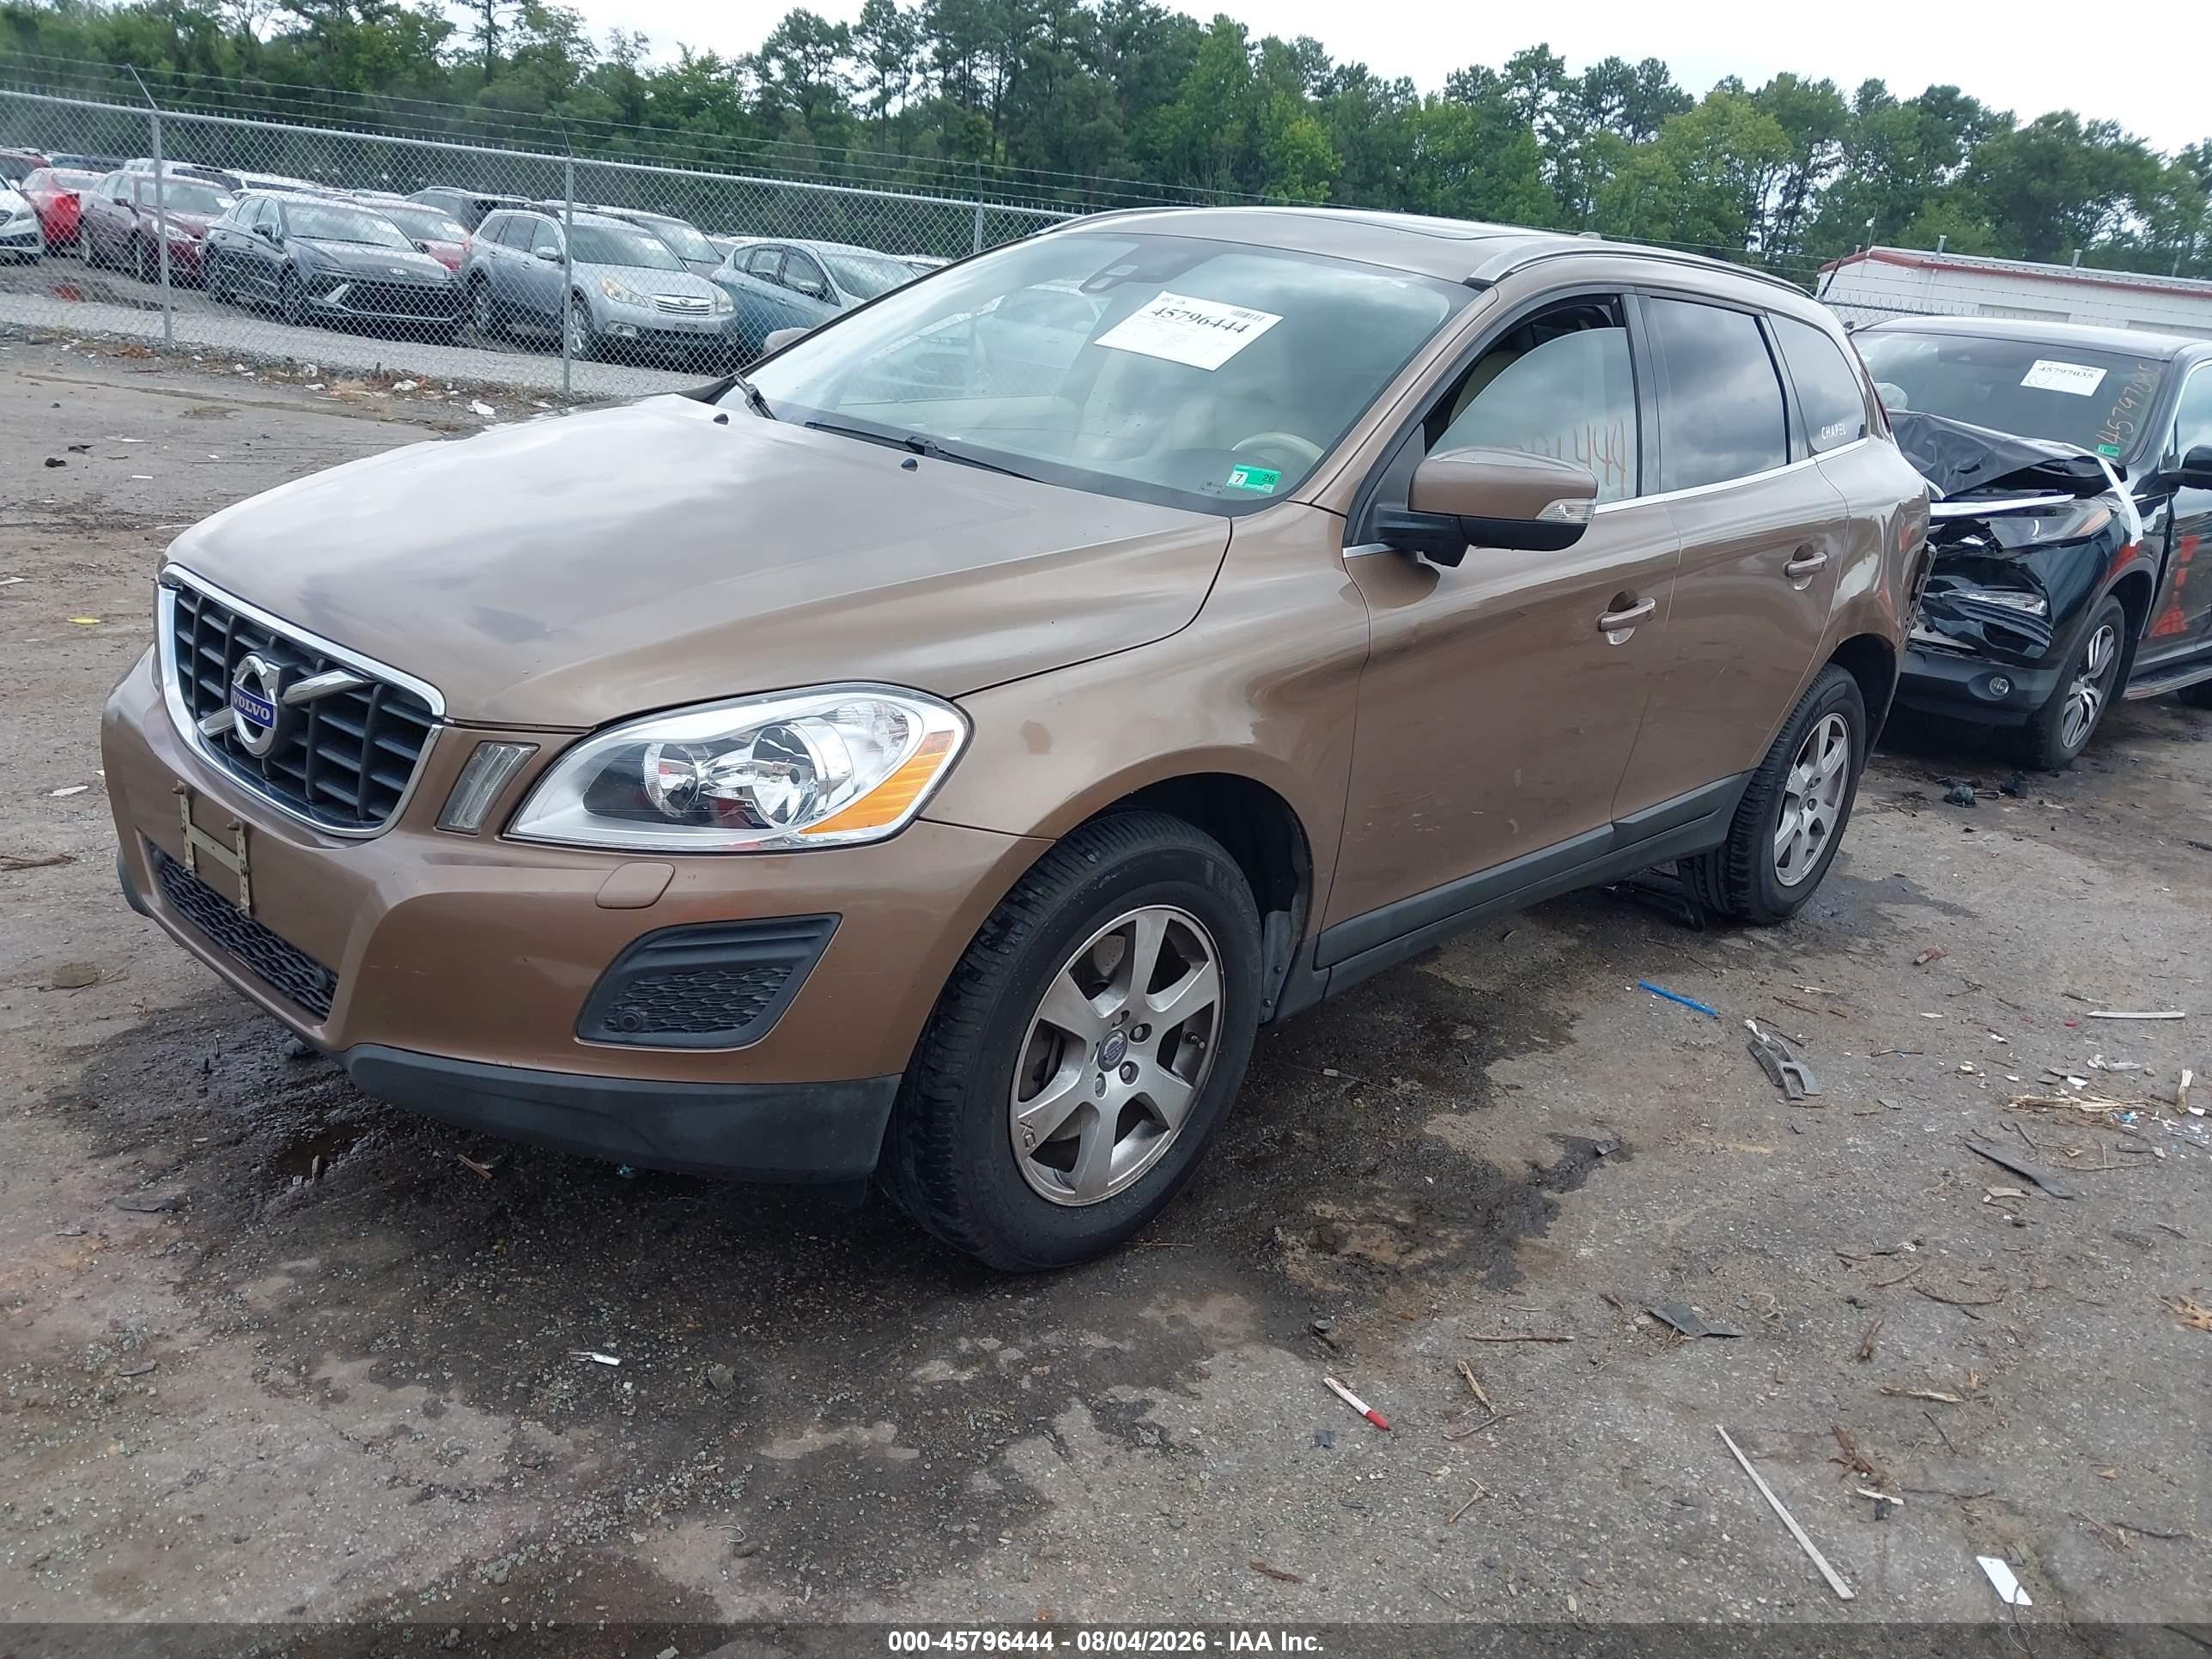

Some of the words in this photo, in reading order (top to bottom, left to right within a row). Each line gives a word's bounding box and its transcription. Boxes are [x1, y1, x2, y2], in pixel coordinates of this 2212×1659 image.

[1151, 307, 1251, 333] 45796444
[1820, 422, 1847, 441] CHAPEL
[1235, 473, 1243, 483] 7
[1262, 473, 1276, 483] 26
[232, 690, 271, 720] VOLVO
[1018, 1117, 1036, 1150] XC
